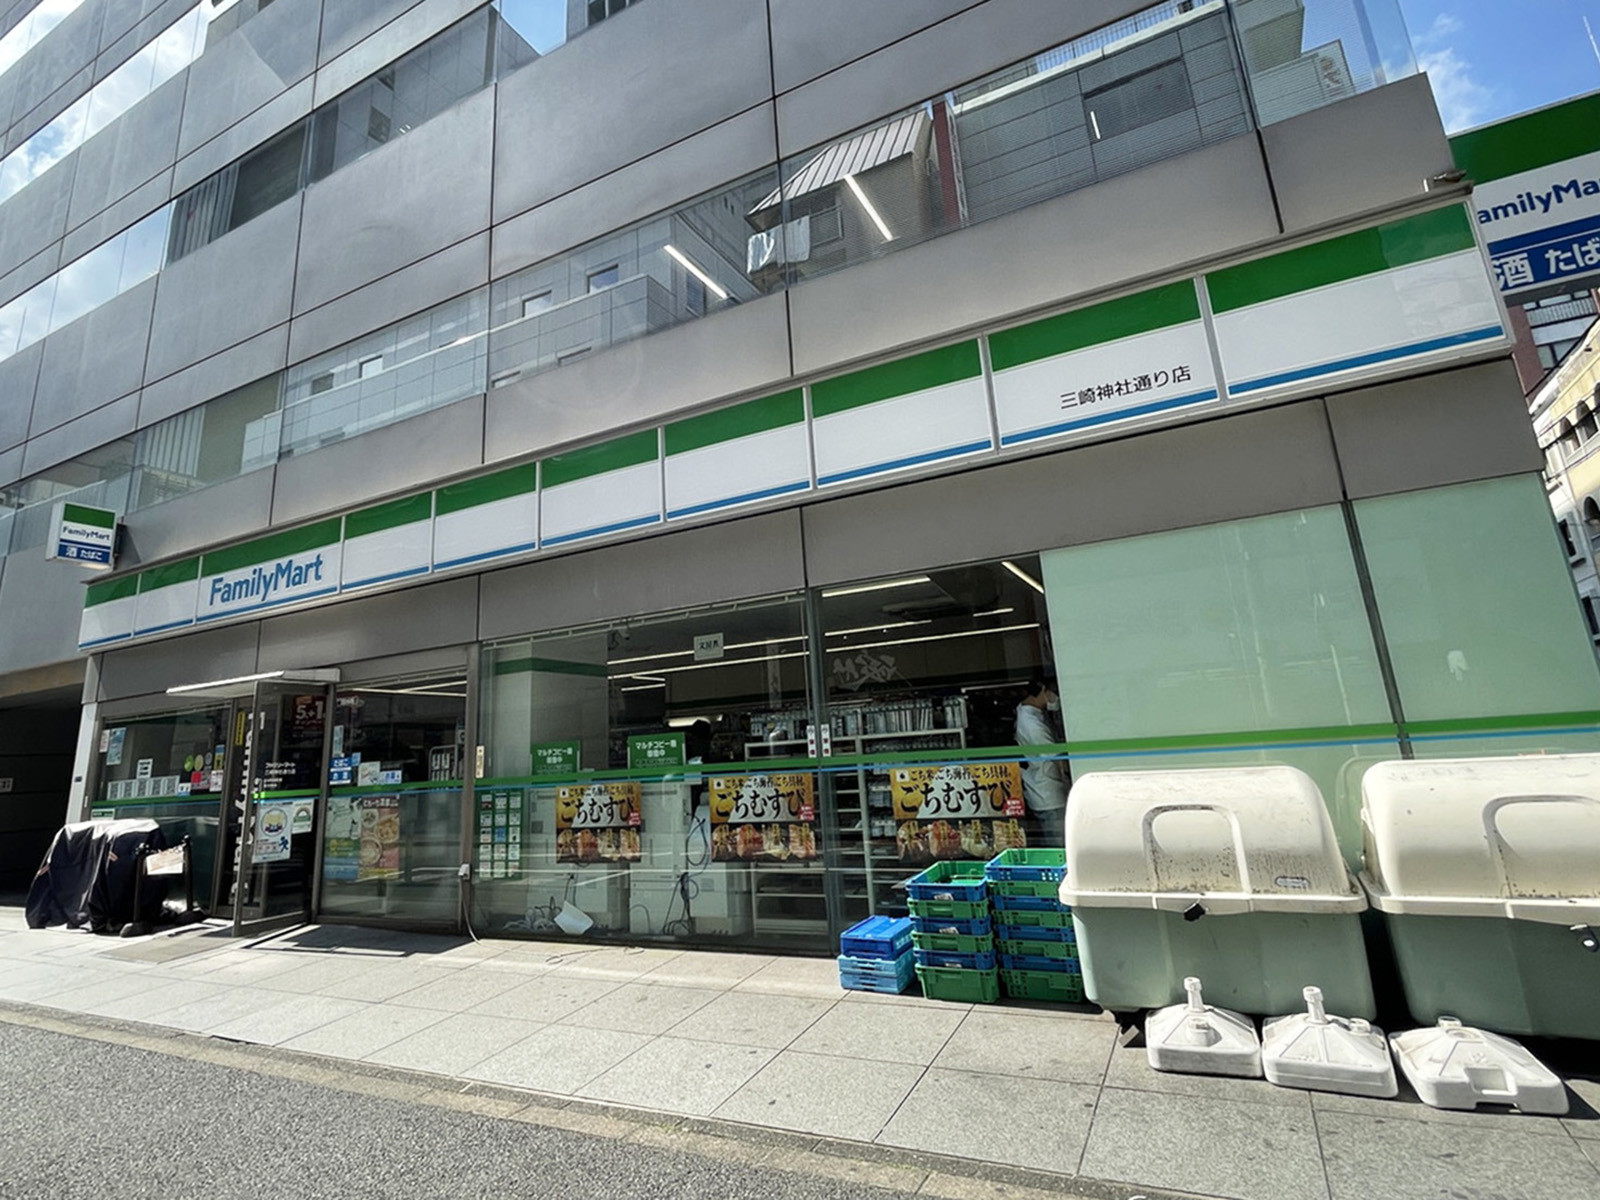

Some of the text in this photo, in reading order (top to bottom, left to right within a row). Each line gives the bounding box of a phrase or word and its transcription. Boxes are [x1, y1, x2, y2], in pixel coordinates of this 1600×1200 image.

[1477, 179, 1600, 224] amilyMa
[1491, 252, 1534, 288] 酒
[1060, 365, 1191, 409] 三崎神社通り店
[62, 526, 110, 541] FamilyMart
[80, 549, 103, 561] たばこ
[209, 553, 323, 606] FamilyMart
[561, 796, 636, 825] ごちむすび
[716, 788, 806, 819] ごちむすび
[900, 780, 1012, 814] ごちむすび
